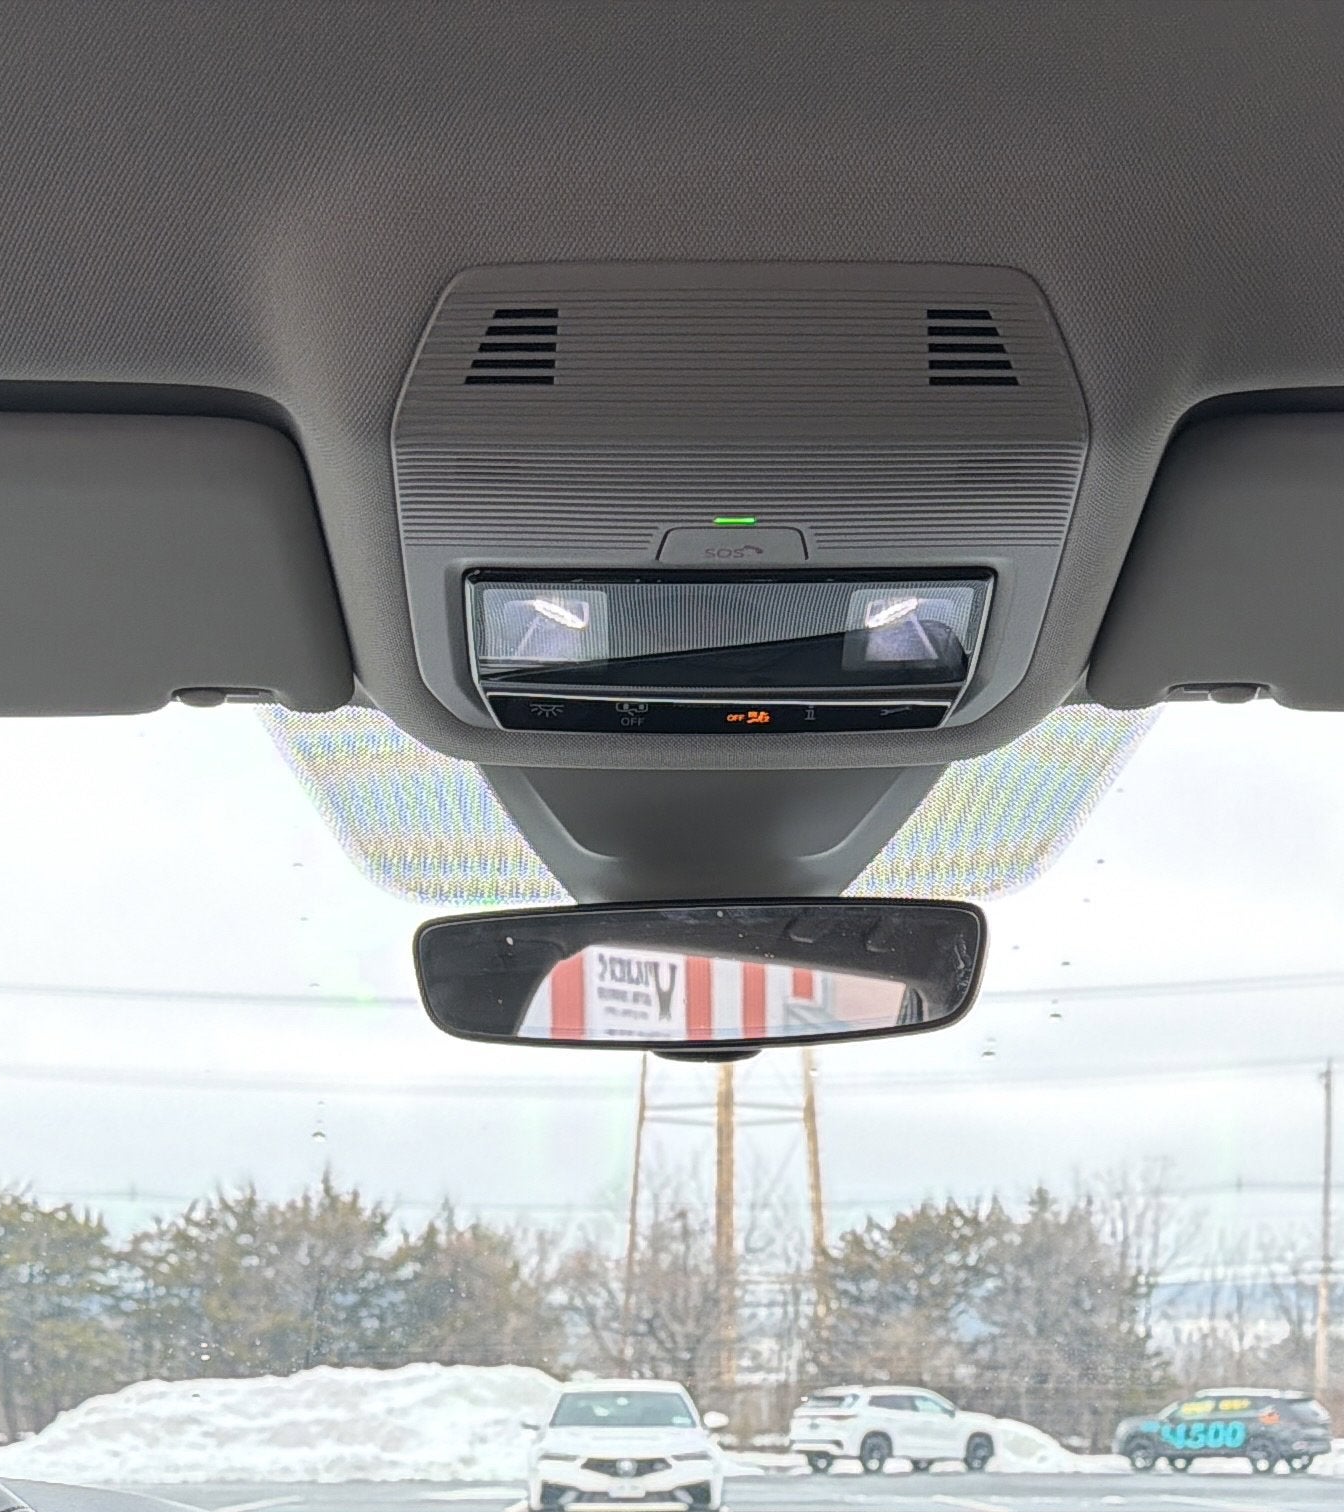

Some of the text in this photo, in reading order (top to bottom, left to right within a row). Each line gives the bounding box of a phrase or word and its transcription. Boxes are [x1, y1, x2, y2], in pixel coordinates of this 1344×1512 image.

[705, 548, 744, 558] SOS
[621, 717, 645, 727] OFF
[726, 713, 746, 722] OFF
